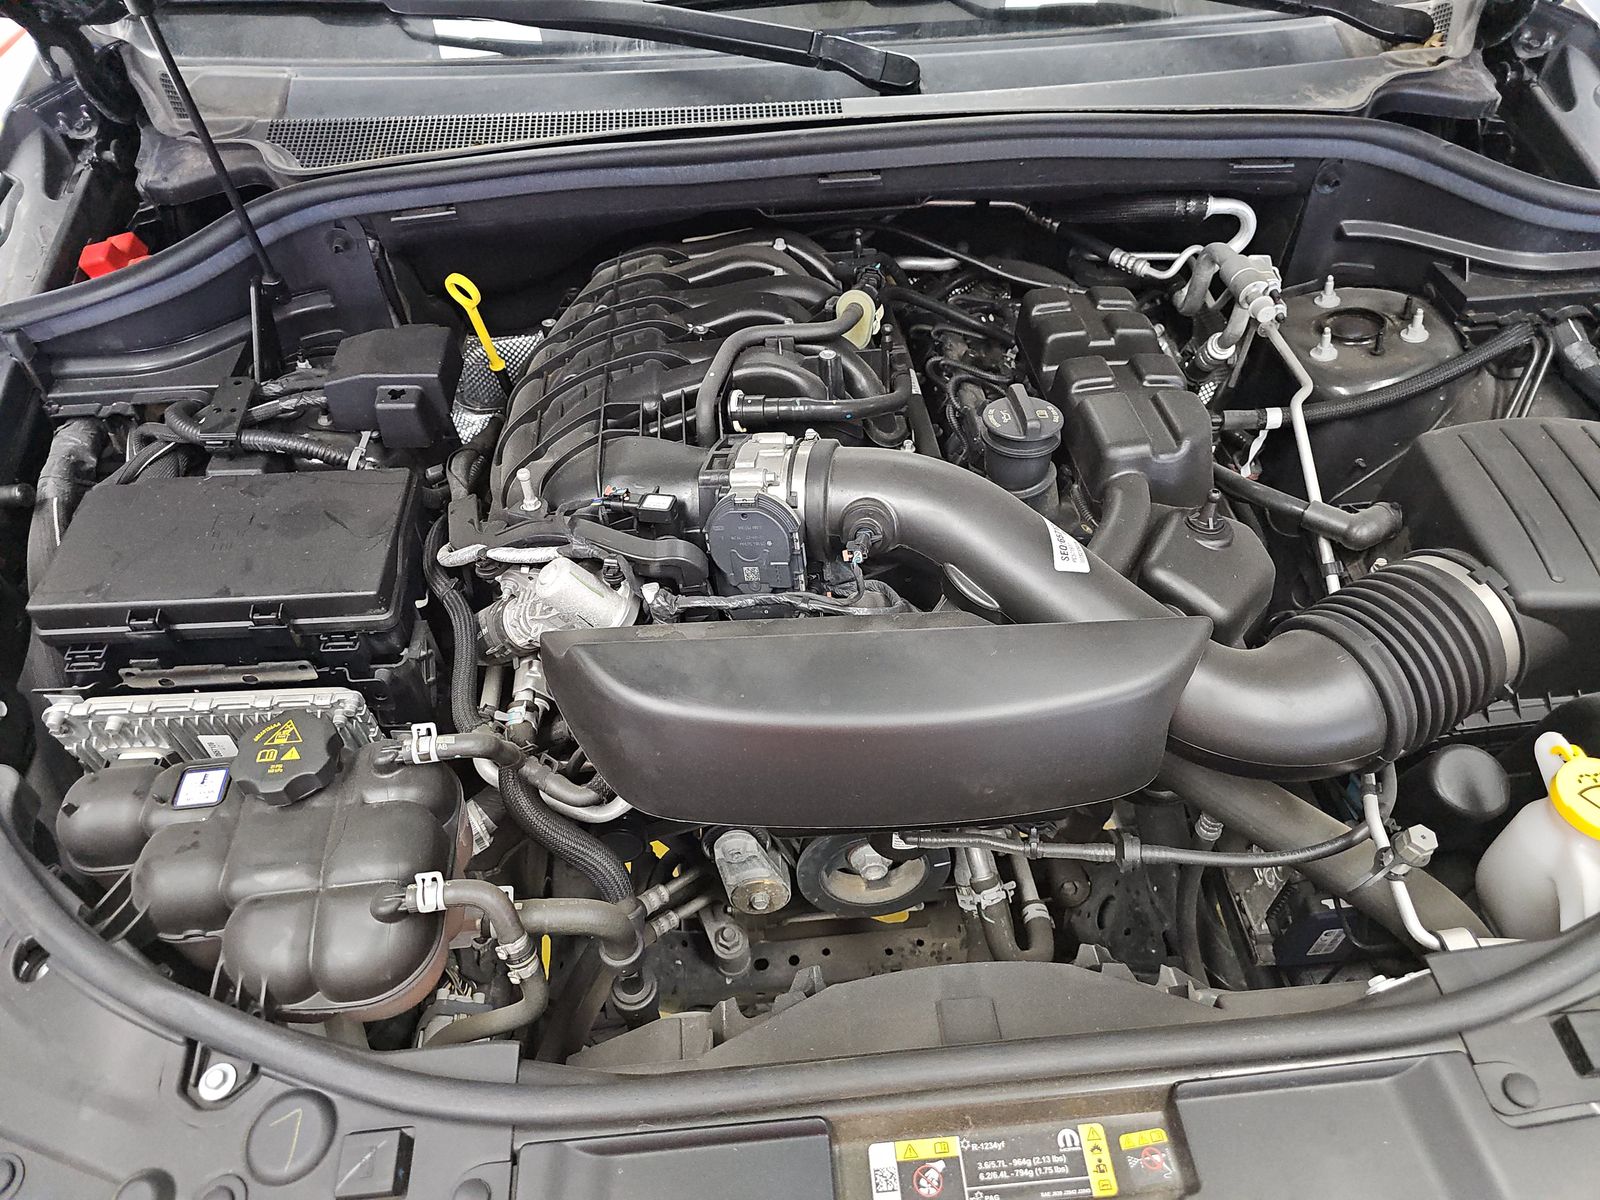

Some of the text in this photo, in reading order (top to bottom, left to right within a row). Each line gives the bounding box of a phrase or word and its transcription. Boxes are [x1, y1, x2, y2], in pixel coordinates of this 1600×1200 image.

[971, 1141, 1005, 1151] R-1234yf
[977, 1160, 1007, 1170] 3.6/5.7L
[1033, 1156, 1051, 1166] (2.13
[1052, 1154, 1067, 1164] lbs)
[1014, 1168, 1033, 1178] 794g
[1035, 1166, 1054, 1177] (1.75
[1054, 1165, 1069, 1174] lbs)
